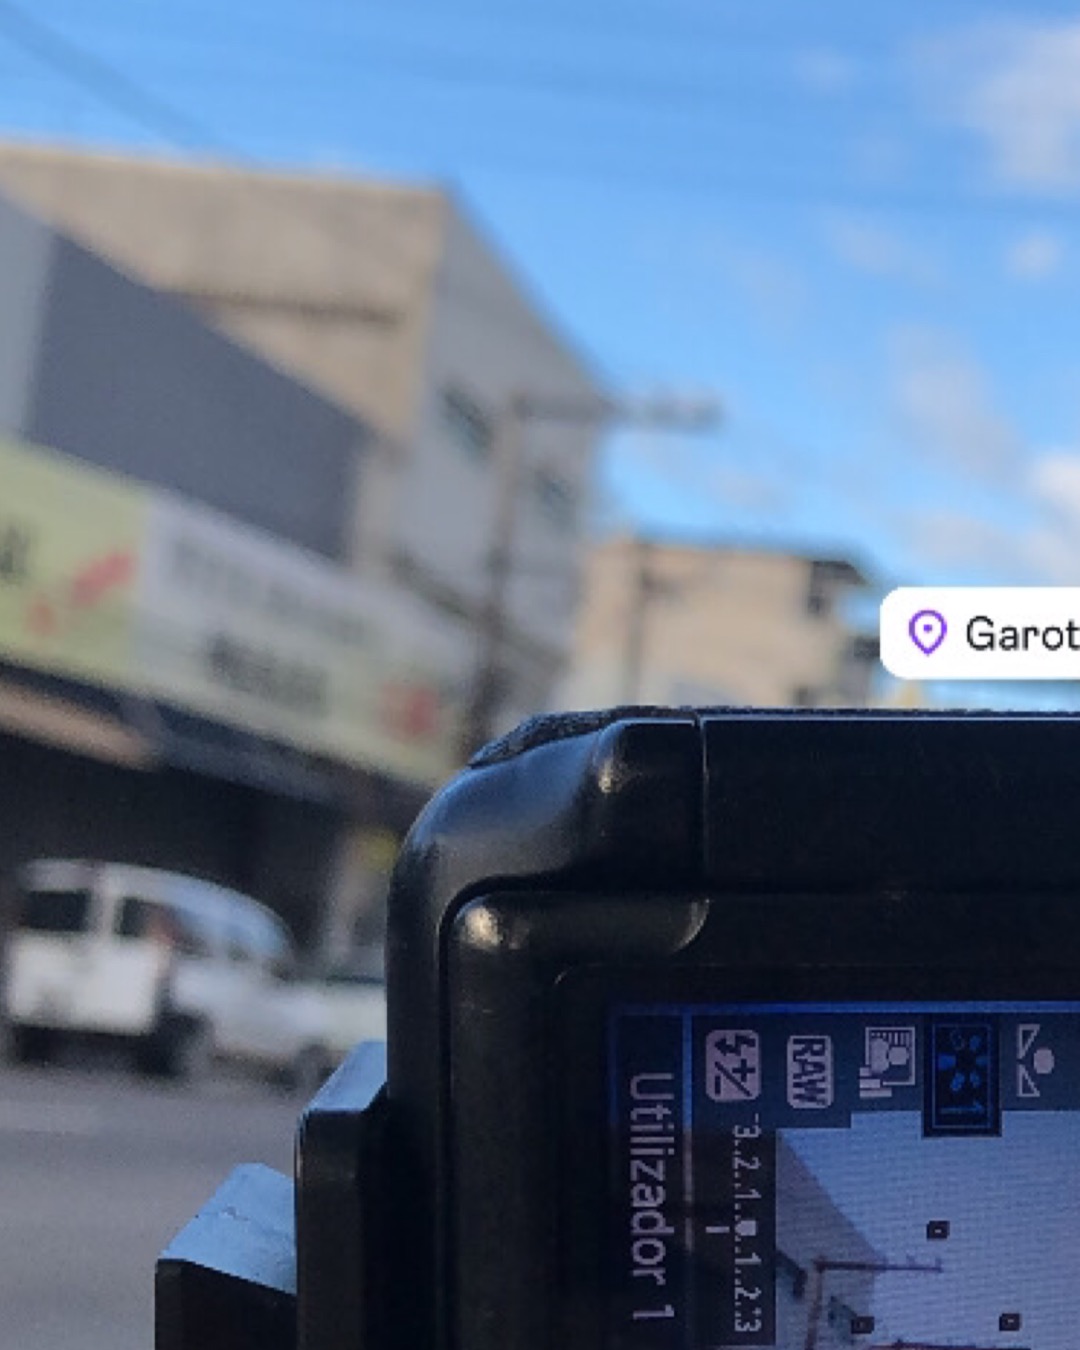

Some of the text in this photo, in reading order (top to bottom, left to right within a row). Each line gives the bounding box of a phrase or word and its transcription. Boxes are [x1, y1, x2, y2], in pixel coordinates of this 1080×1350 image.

[792, 1037, 827, 1103] RAW
[629, 1071, 676, 1321] Utilizador 1
